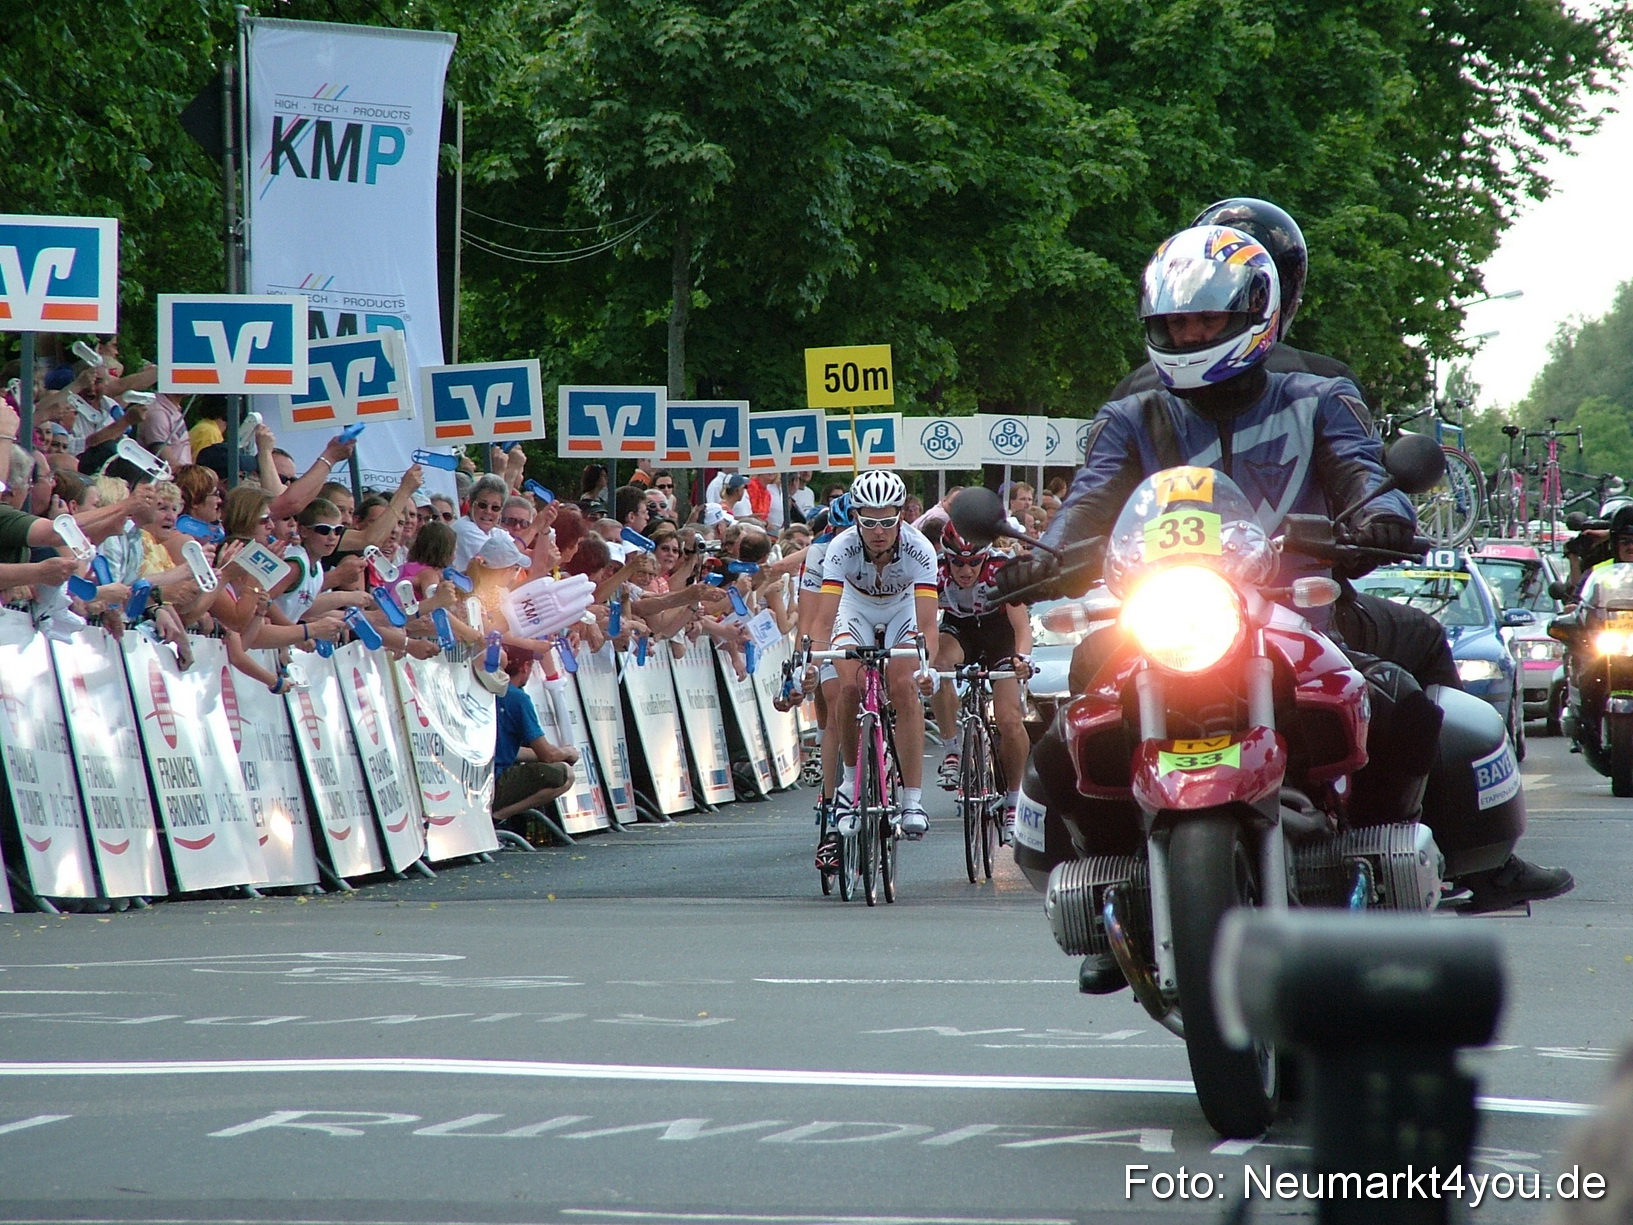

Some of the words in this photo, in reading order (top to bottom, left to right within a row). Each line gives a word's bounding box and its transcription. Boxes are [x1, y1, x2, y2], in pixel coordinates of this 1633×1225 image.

[274, 98, 299, 110] HIGH
[312, 102, 339, 114] TECH
[353, 106, 411, 120] PRODUCTS
[270, 115, 406, 185] KMP
[343, 297, 406, 309] PRODUCTS
[824, 362, 889, 393] 50m
[1163, 475, 1207, 492] TV
[1158, 516, 1206, 549] 33
[521, 598, 541, 625] KMP
[1180, 738, 1225, 750] TV
[156, 756, 202, 789] FRANKEN
[1175, 752, 1223, 767] 33
[166, 793, 212, 828] BRUNNEN
